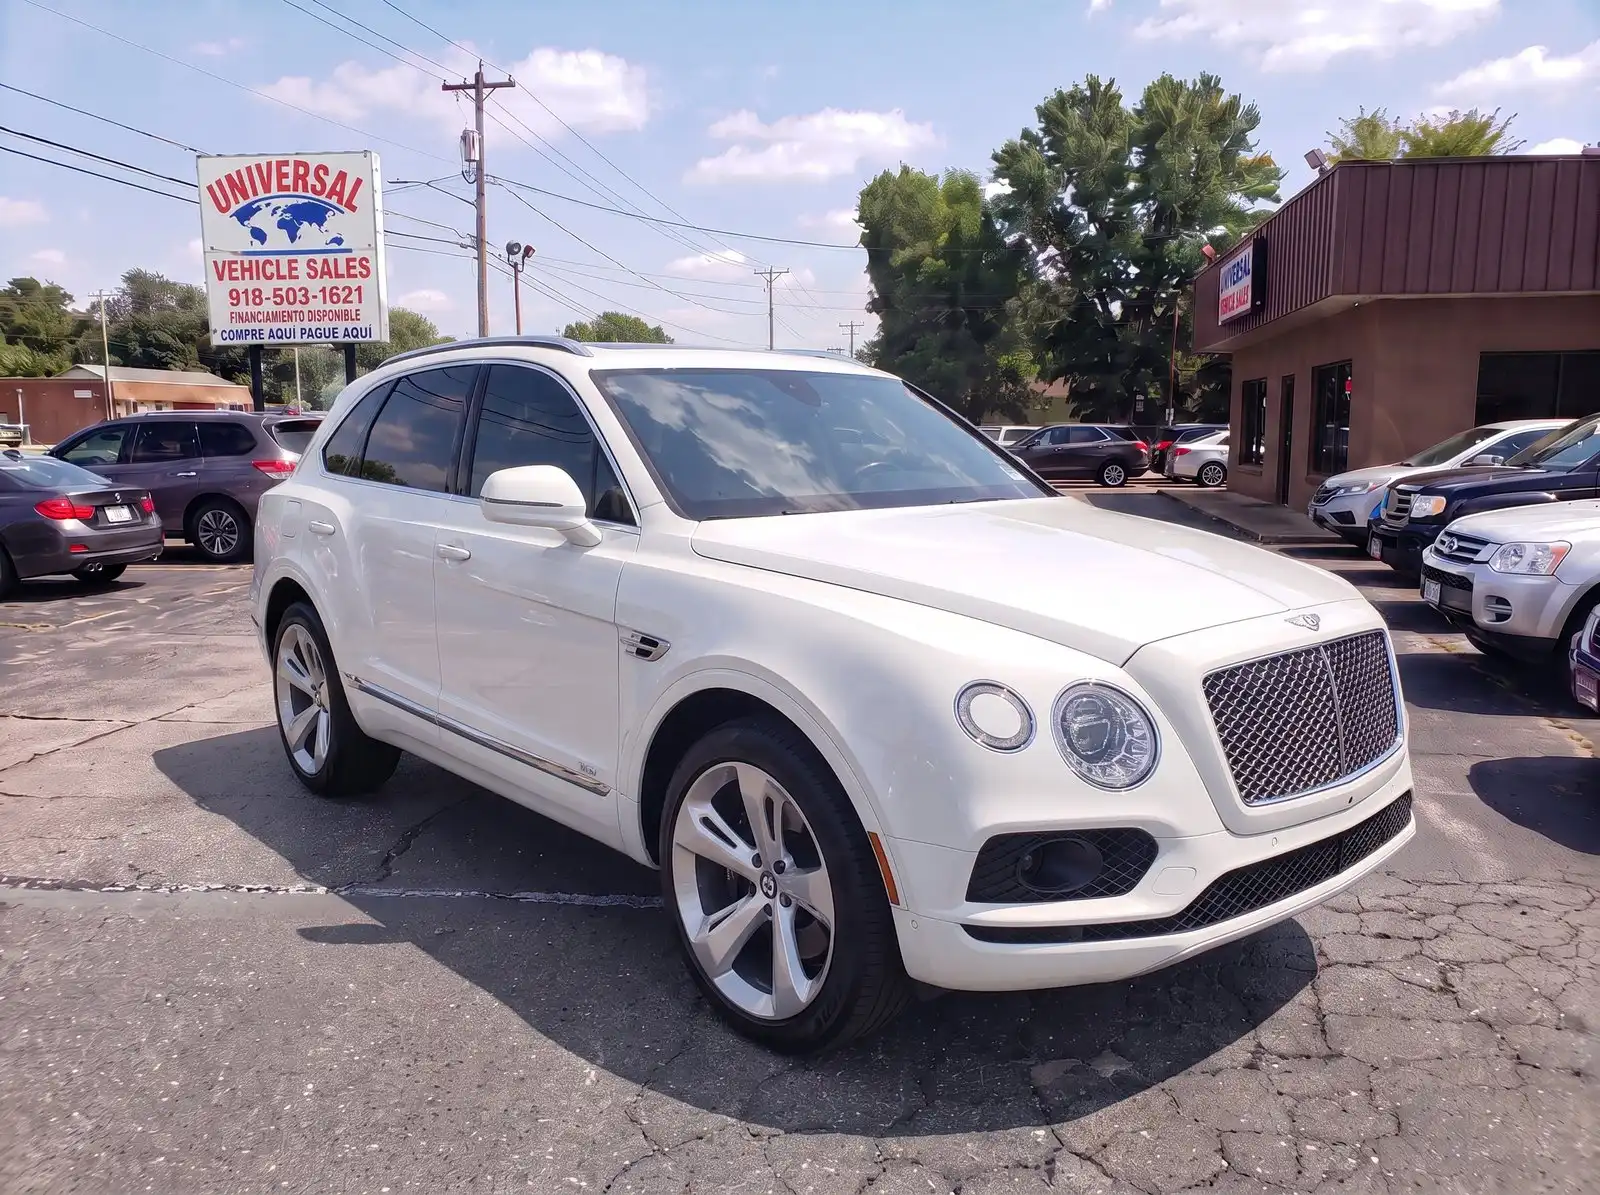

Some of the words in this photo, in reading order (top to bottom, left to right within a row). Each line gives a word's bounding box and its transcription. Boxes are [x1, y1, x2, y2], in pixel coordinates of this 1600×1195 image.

[206, 159, 364, 214] UNIVERSAL
[212, 259, 300, 281] VEHICLE
[306, 256, 371, 279] SALES
[228, 285, 363, 307] 918-503-1621
[229, 310, 305, 324] FINANCIAMIENTO
[307, 308, 361, 323] DISPONIBLE
[220, 328, 265, 341] COMPRE
[300, 327, 339, 340] PAGUE
[343, 324, 372, 339] AQUÍ
